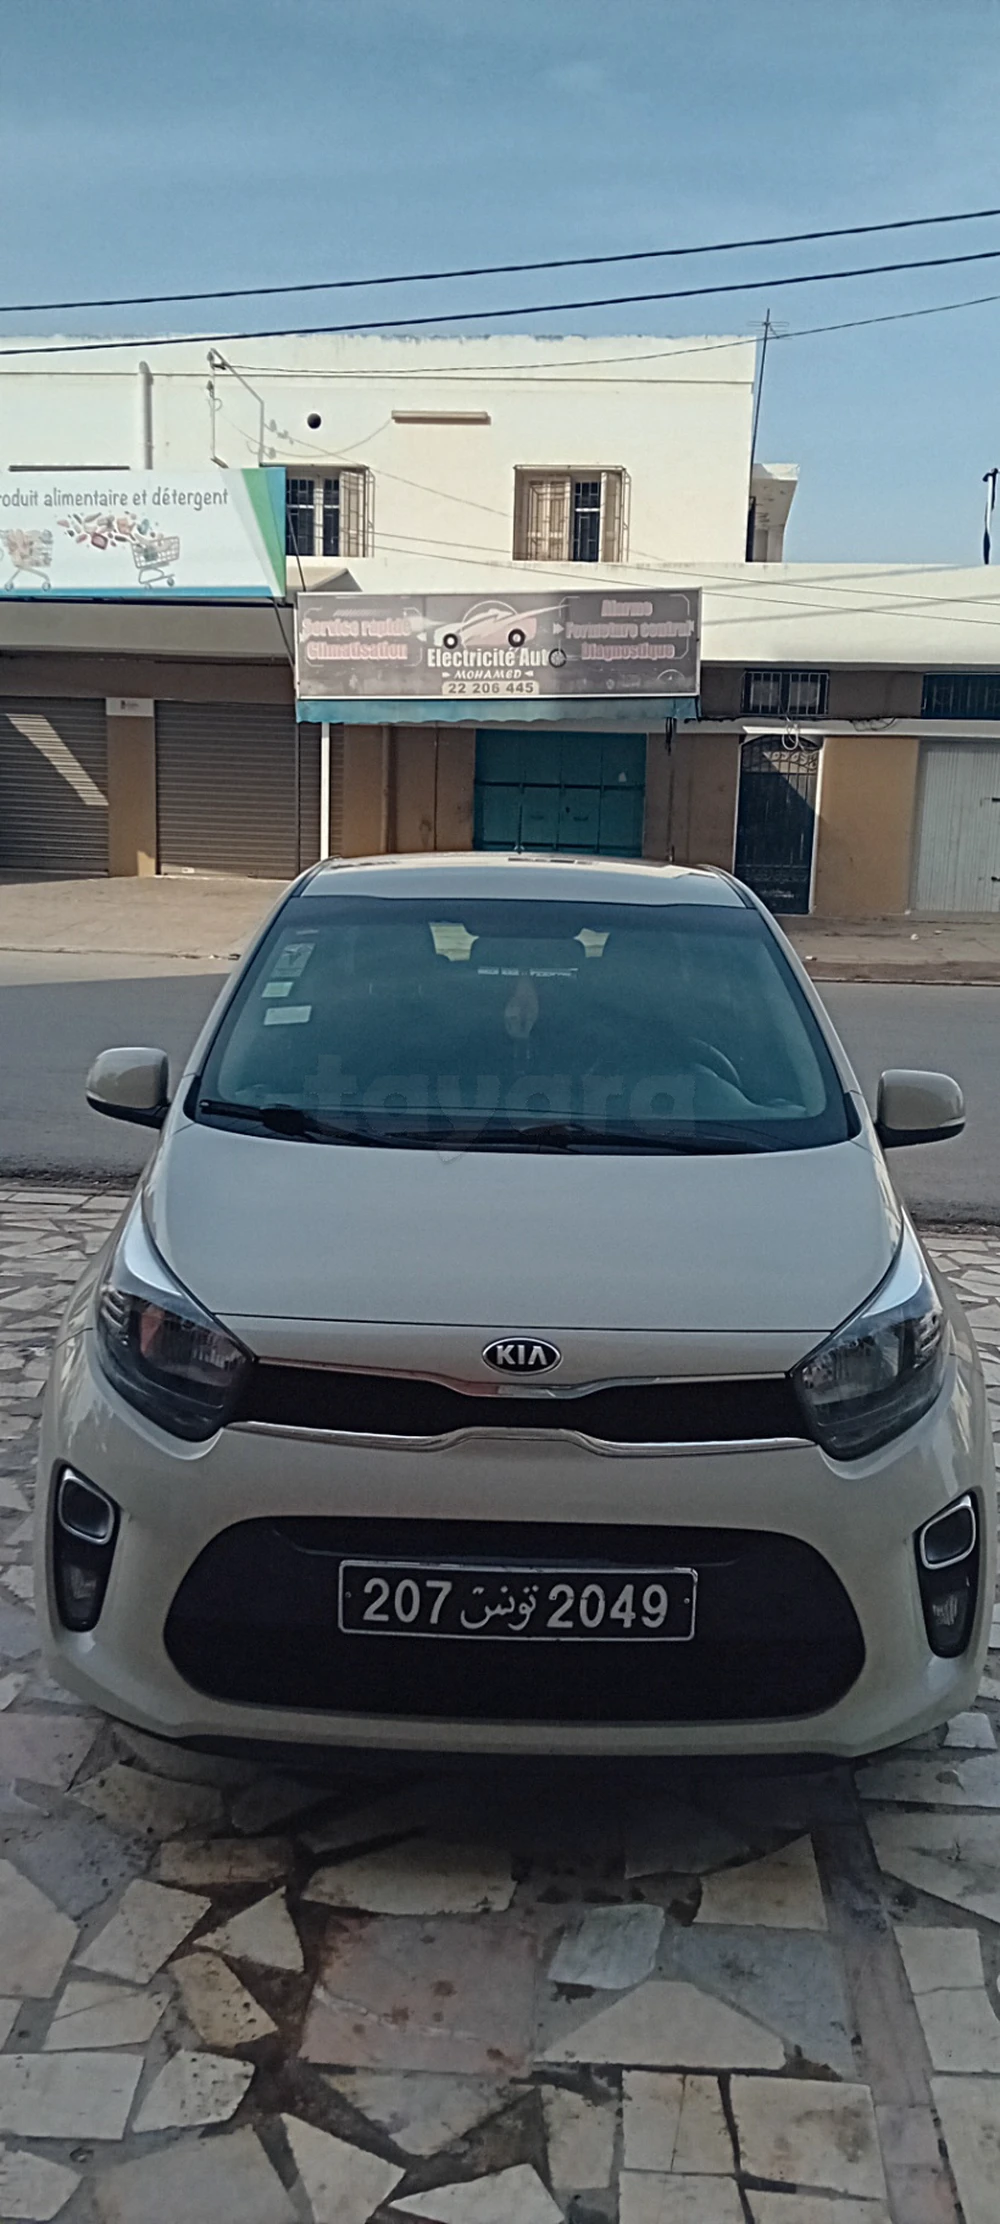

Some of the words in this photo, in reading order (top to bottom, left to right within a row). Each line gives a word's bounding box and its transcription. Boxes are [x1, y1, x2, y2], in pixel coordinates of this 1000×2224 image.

[0, 488, 38, 507] oduit
[44, 487, 128, 506] alimentaire
[133, 489, 147, 506] et
[152, 486, 228, 511] détergent
[601, 600, 653, 617] Alarme
[302, 618, 359, 637] Service
[361, 618, 412, 638] rapide
[306, 640, 408, 660] Climatisation
[427, 647, 516, 668] Electricité
[581, 642, 675, 662] Diagnostique
[448, 682, 466, 693] 22
[472, 682, 500, 693] 206
[506, 682, 534, 693] 445
[496, 1344, 548, 1366] KIA
[362, 1577, 452, 1625] 207
[459, 1586, 539, 1631] تونس
[546, 1584, 669, 1629] 2049
